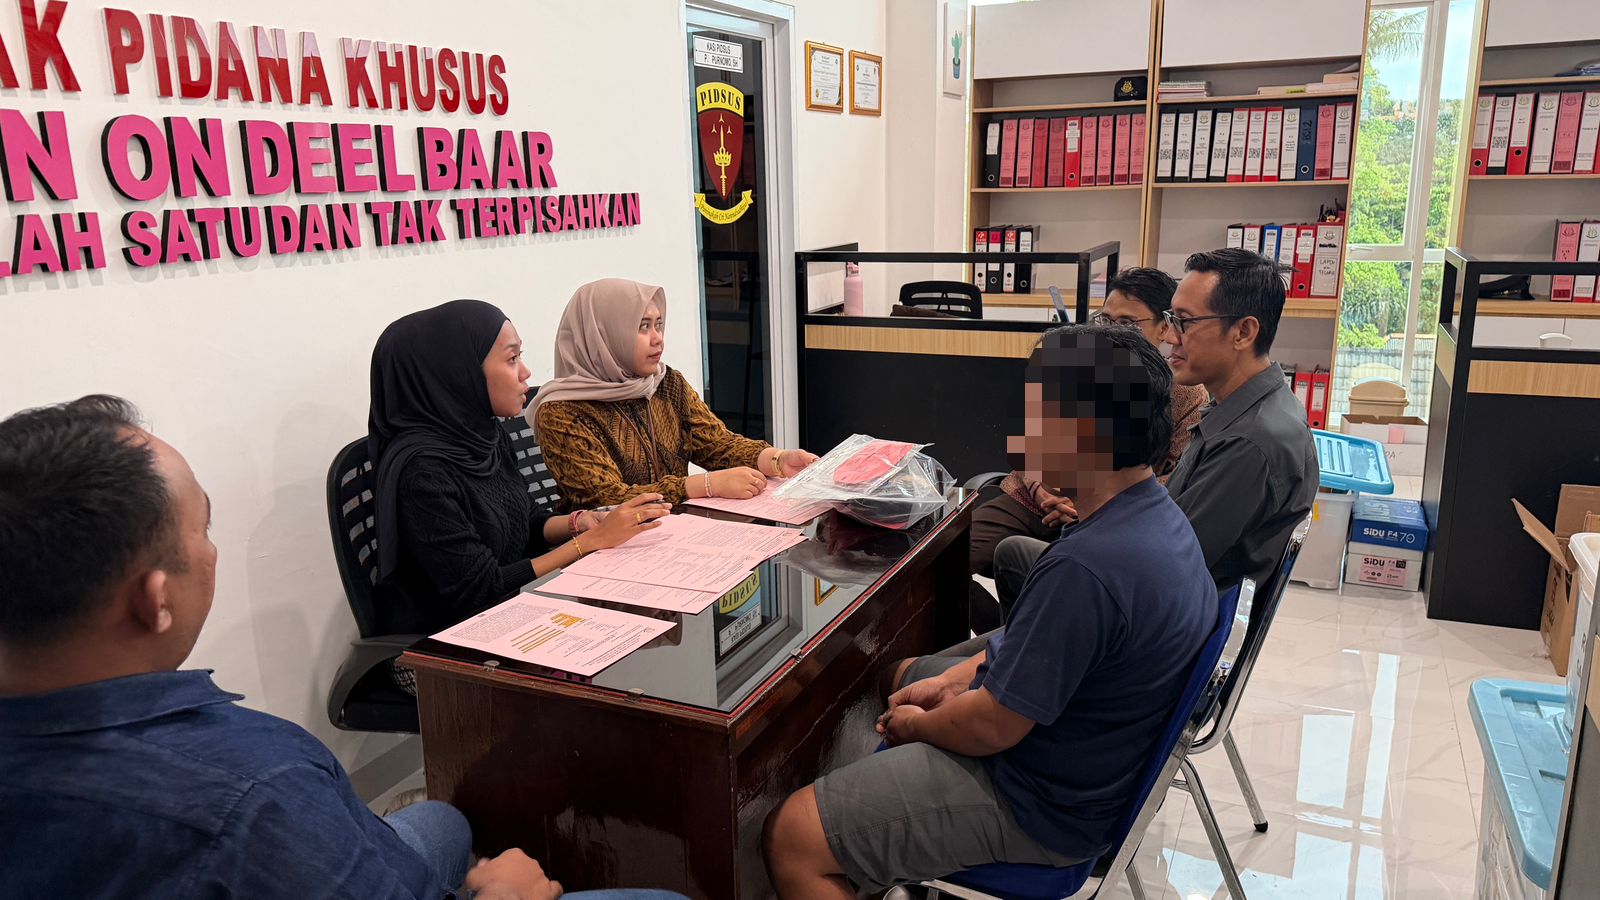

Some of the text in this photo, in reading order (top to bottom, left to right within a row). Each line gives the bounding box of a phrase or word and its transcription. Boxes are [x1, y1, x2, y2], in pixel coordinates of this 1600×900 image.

[102, 7, 333, 106] PIDANA
[339, 37, 509, 116] KHUSUS
[700, 88, 742, 110] PIDSUS
[0, 192, 641, 277] AH SATU DAN TAK TERPISAHKAN
[1363, 527, 1385, 537] SiDU
[1363, 557, 1385, 567] SiDU
